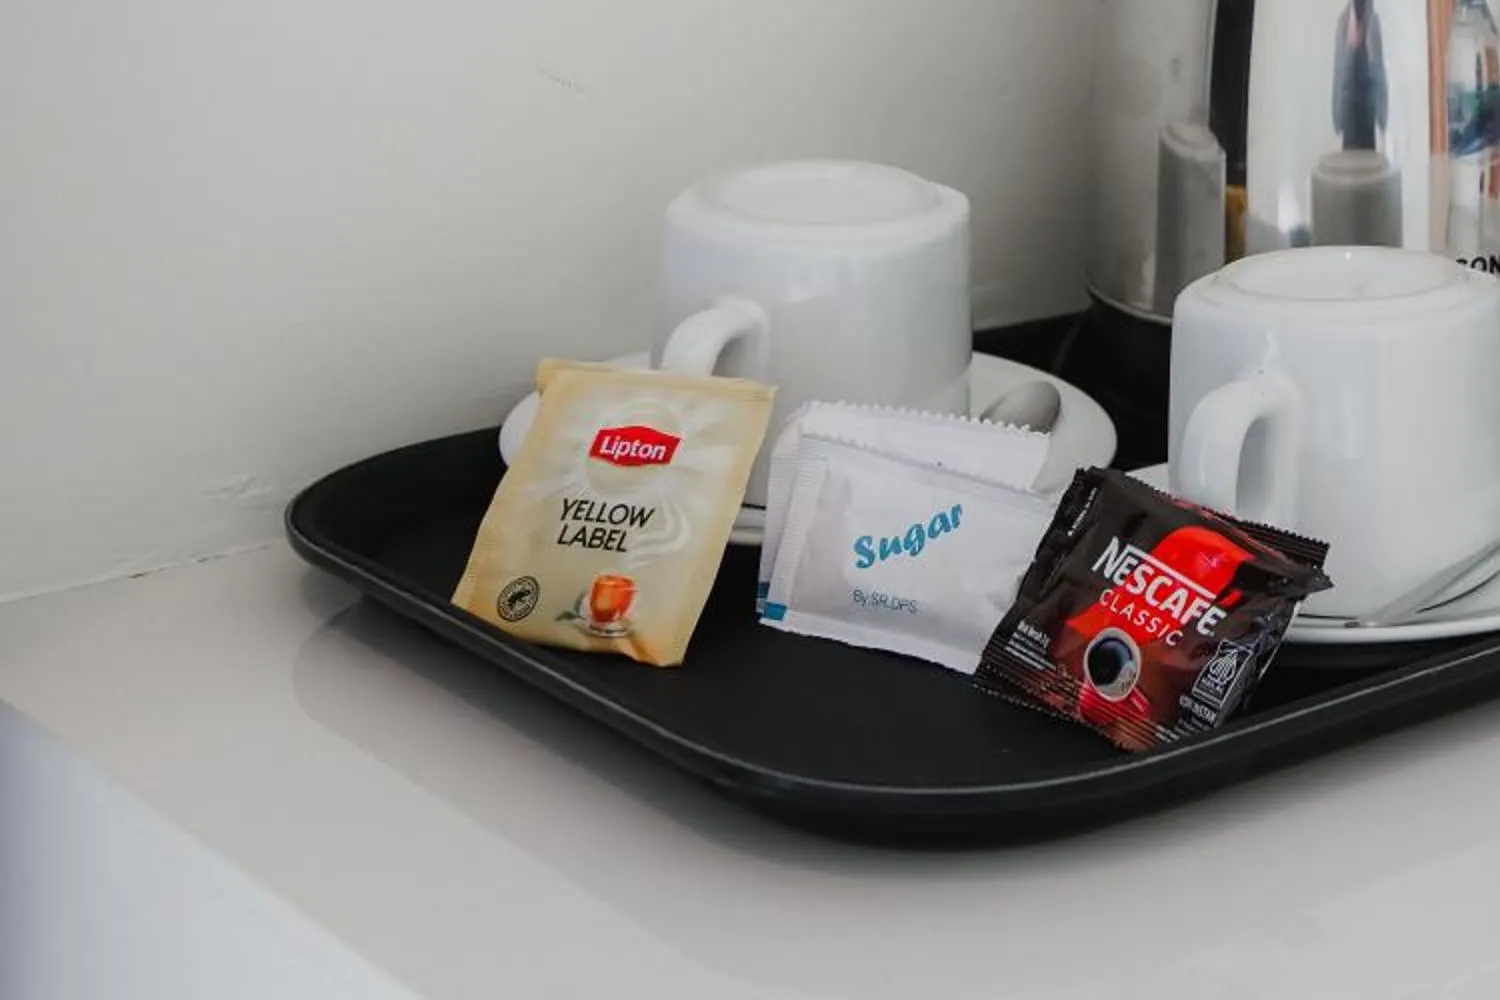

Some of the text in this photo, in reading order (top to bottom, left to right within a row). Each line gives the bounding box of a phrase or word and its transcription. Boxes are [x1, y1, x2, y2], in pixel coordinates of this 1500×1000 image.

[600, 436, 667, 460] Lipton
[560, 499, 655, 528] YELLOW
[557, 528, 628, 552] LABEL
[854, 503, 962, 569] Sugar
[1100, 589, 1184, 647] CLASSIC
